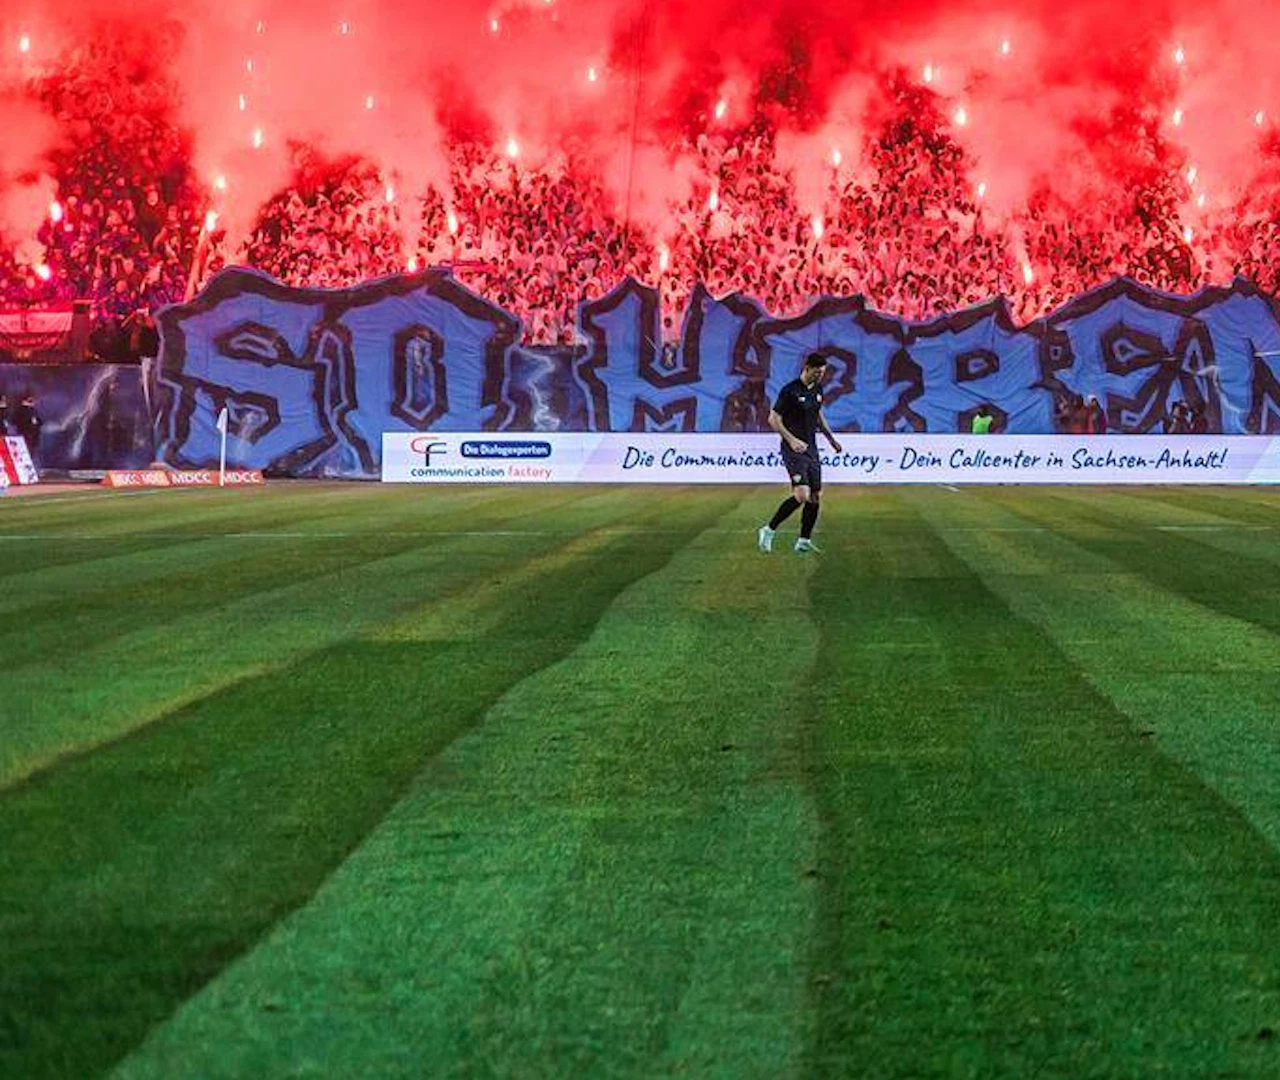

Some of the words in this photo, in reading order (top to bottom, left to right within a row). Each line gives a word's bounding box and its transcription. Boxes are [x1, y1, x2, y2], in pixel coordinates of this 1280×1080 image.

[622, 446, 655, 469] Die
[900, 447, 942, 470] Dein
[949, 447, 1040, 469] Callcenter
[1046, 452, 1064, 468] in
[1071, 447, 1229, 470] Sachsen-Anhalt!
[410, 466, 505, 477] communication
[508, 466, 553, 479] factory
